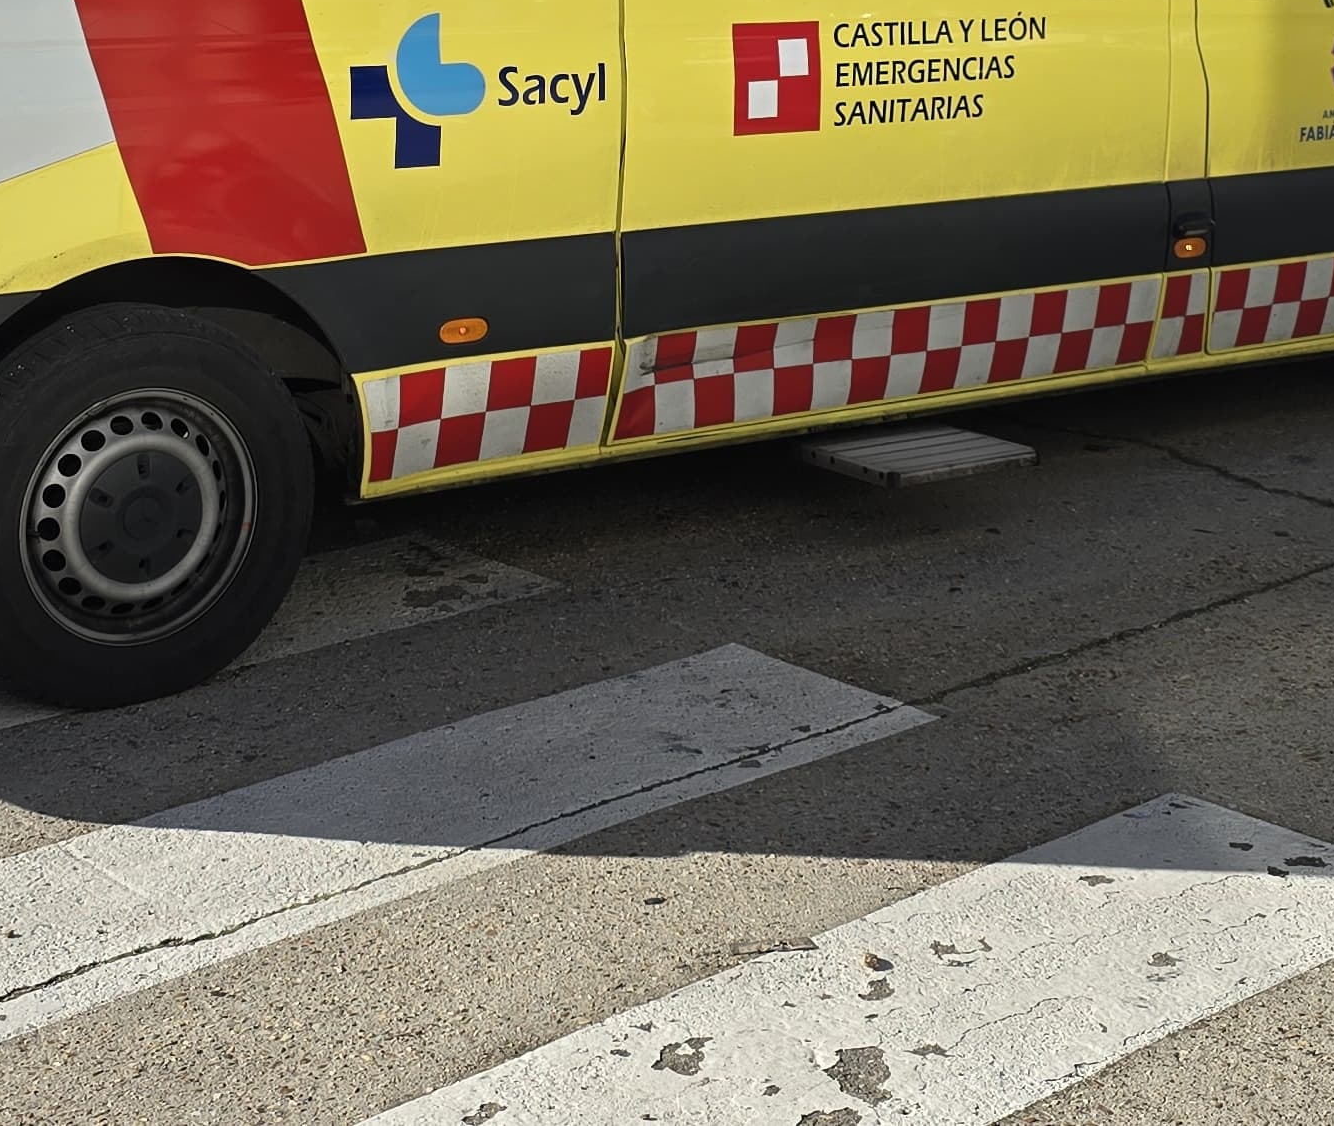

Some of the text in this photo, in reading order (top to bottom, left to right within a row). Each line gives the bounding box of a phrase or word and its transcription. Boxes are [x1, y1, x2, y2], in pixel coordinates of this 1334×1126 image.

[833, 12, 1046, 47] CASTILLA Y LEÓN
[835, 55, 1015, 88] EMERGENCIAS
[498, 63, 606, 115] Sacyl
[834, 94, 984, 127] SANITARIAS
